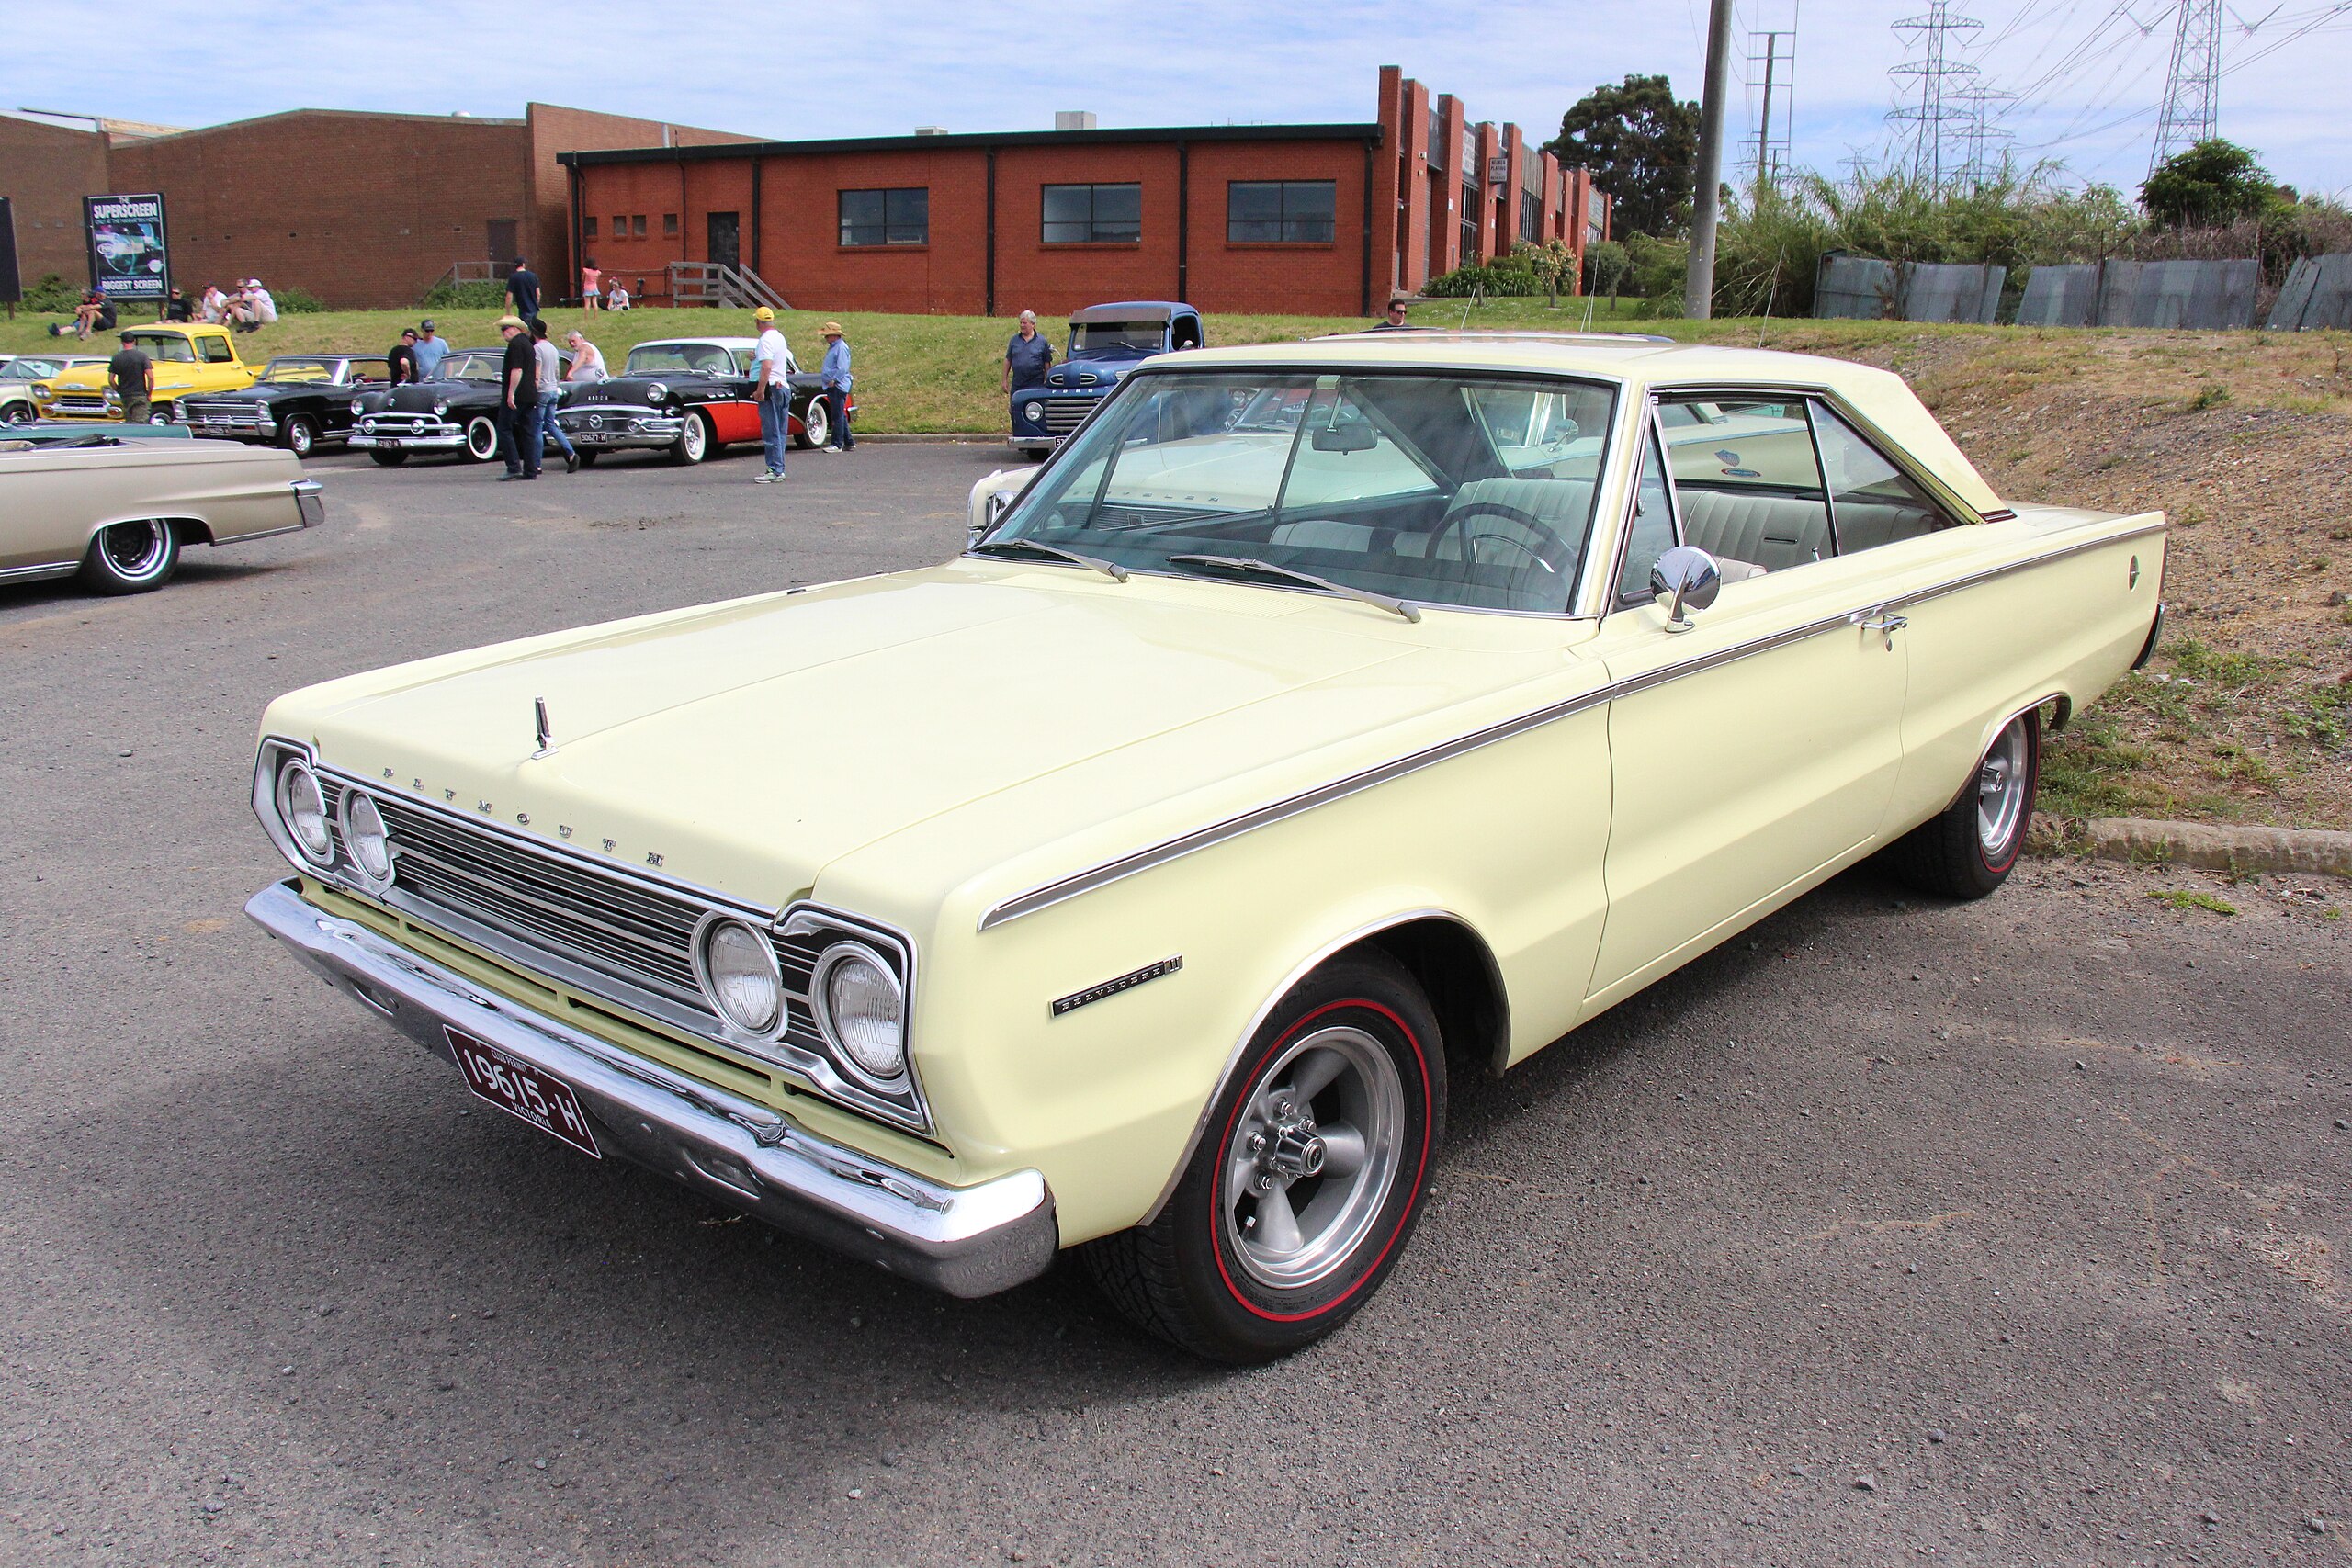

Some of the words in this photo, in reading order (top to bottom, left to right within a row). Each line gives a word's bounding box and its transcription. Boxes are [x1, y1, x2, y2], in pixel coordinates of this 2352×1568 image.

[94, 203, 158, 219] SUPERSCREEN
[102, 280, 132, 290] BIGGEST
[133, 279, 163, 289] SCREEN
[383, 766, 665, 868] PLYMOUTH
[1062, 967, 1161, 1010] BELVEDERE
[491, 1049, 506, 1064] CLUB
[506, 1056, 528, 1074] PERMIT
[511, 1101, 554, 1130] VICTORIA
